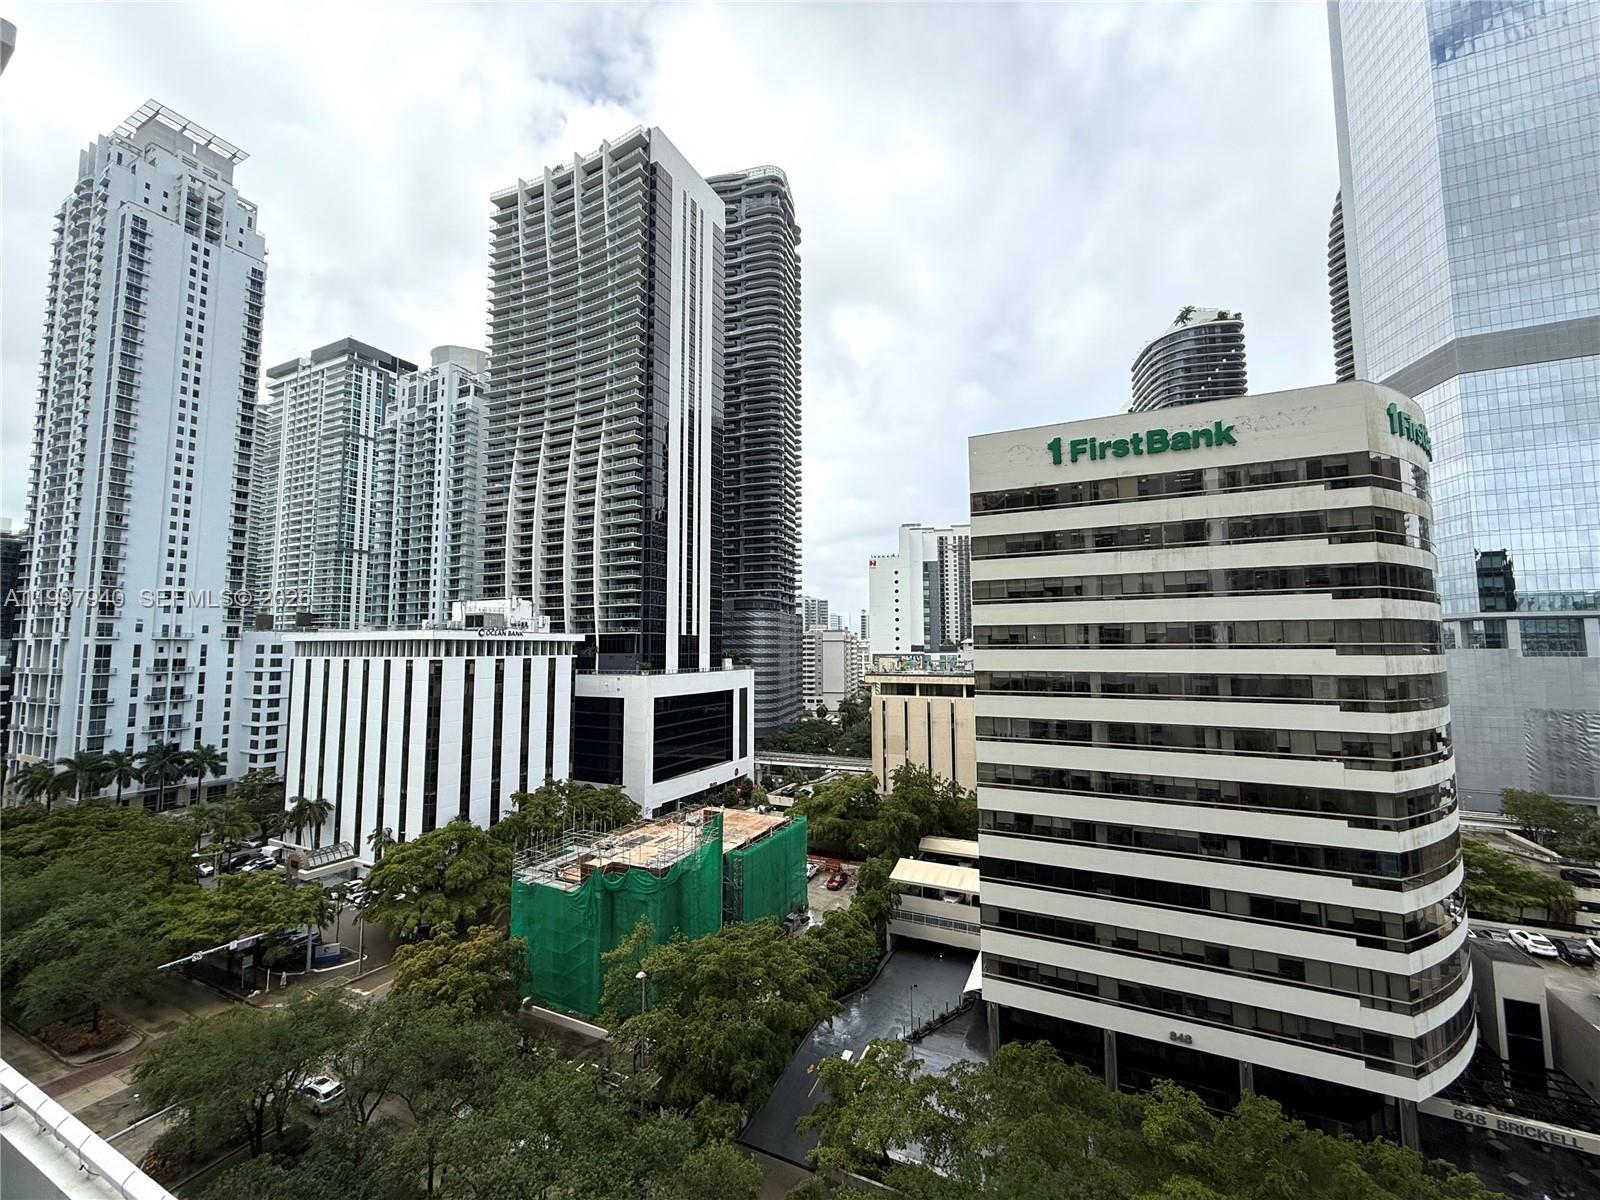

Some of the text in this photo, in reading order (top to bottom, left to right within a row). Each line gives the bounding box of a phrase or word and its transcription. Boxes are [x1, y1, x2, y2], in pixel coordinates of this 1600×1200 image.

[1070, 420, 1238, 463] FirstBank
[486, 629, 507, 637] OCEAN
[1169, 1031, 1193, 1045] 848
[1453, 1108, 1585, 1150] 848 BRICKELL
